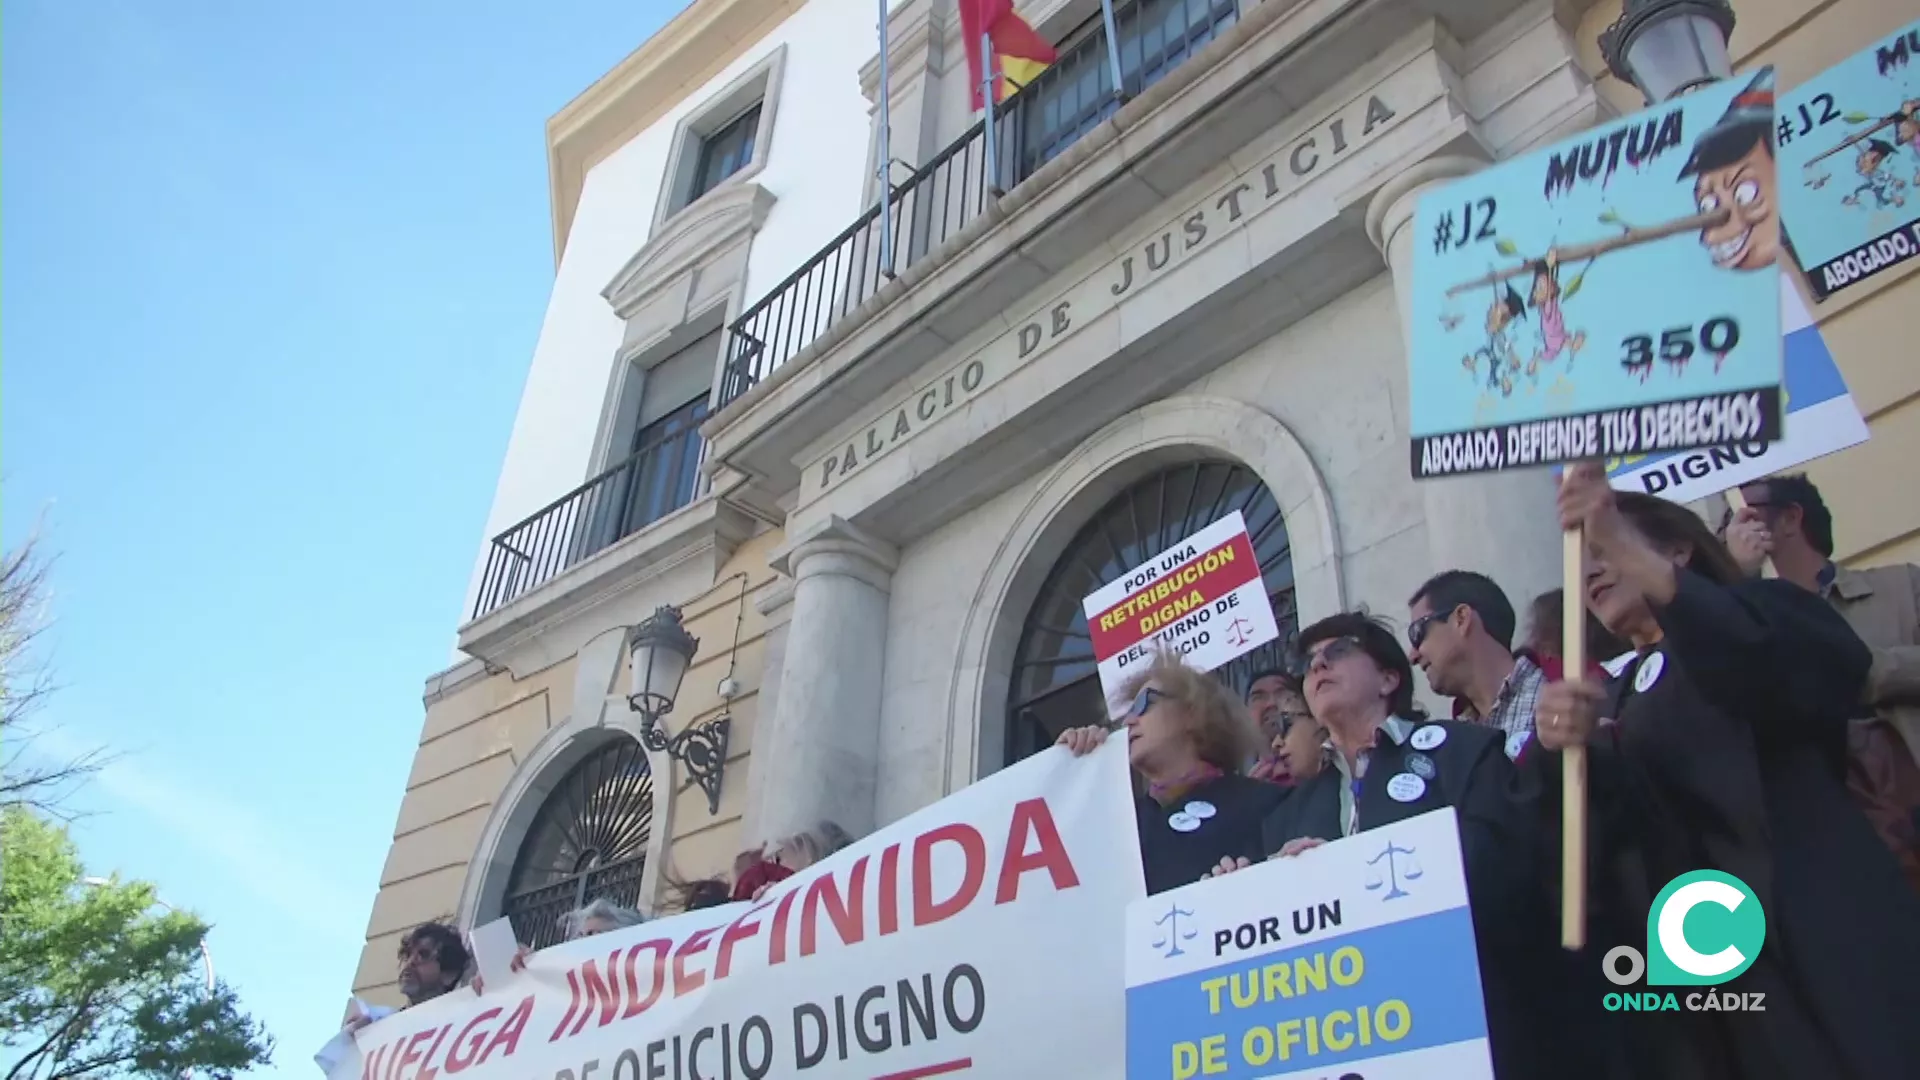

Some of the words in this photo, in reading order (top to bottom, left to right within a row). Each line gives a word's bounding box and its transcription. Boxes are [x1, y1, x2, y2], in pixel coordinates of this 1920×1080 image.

[1544, 109, 1684, 198] MUTUA
[1777, 92, 1841, 147] #J2
[1433, 196, 1497, 256] #J2
[1823, 232, 1917, 291] ABOGADO,
[820, 361, 985, 489] PALACIO
[1017, 302, 1071, 359] DE
[1110, 95, 1396, 296] JUSTICIA
[1620, 316, 1740, 374] 350
[1421, 428, 1504, 475] ABOGADO,
[1507, 414, 1598, 465] DEFIENDE
[1601, 408, 1637, 454] TUS
[1641, 391, 1762, 450] DERECHOS
[1099, 545, 1235, 632] RETRIBUCIÓN
[1124, 566, 1157, 594] POR
[1161, 545, 1198, 571] UNA
[1118, 645, 1149, 669] DEL
[1152, 608, 1211, 646] TURNO
[1215, 592, 1240, 615] DE
[1139, 589, 1205, 635] DIGNA
[548, 796, 1081, 1043] INDEFINIDA
[1214, 916, 1281, 957] POR
[1292, 898, 1342, 935] UN
[793, 963, 985, 1070] DIGNO
[1201, 945, 1364, 1015] TURNO
[1171, 1034, 1229, 1080] DE
[1241, 998, 1411, 1066] OFICIO
